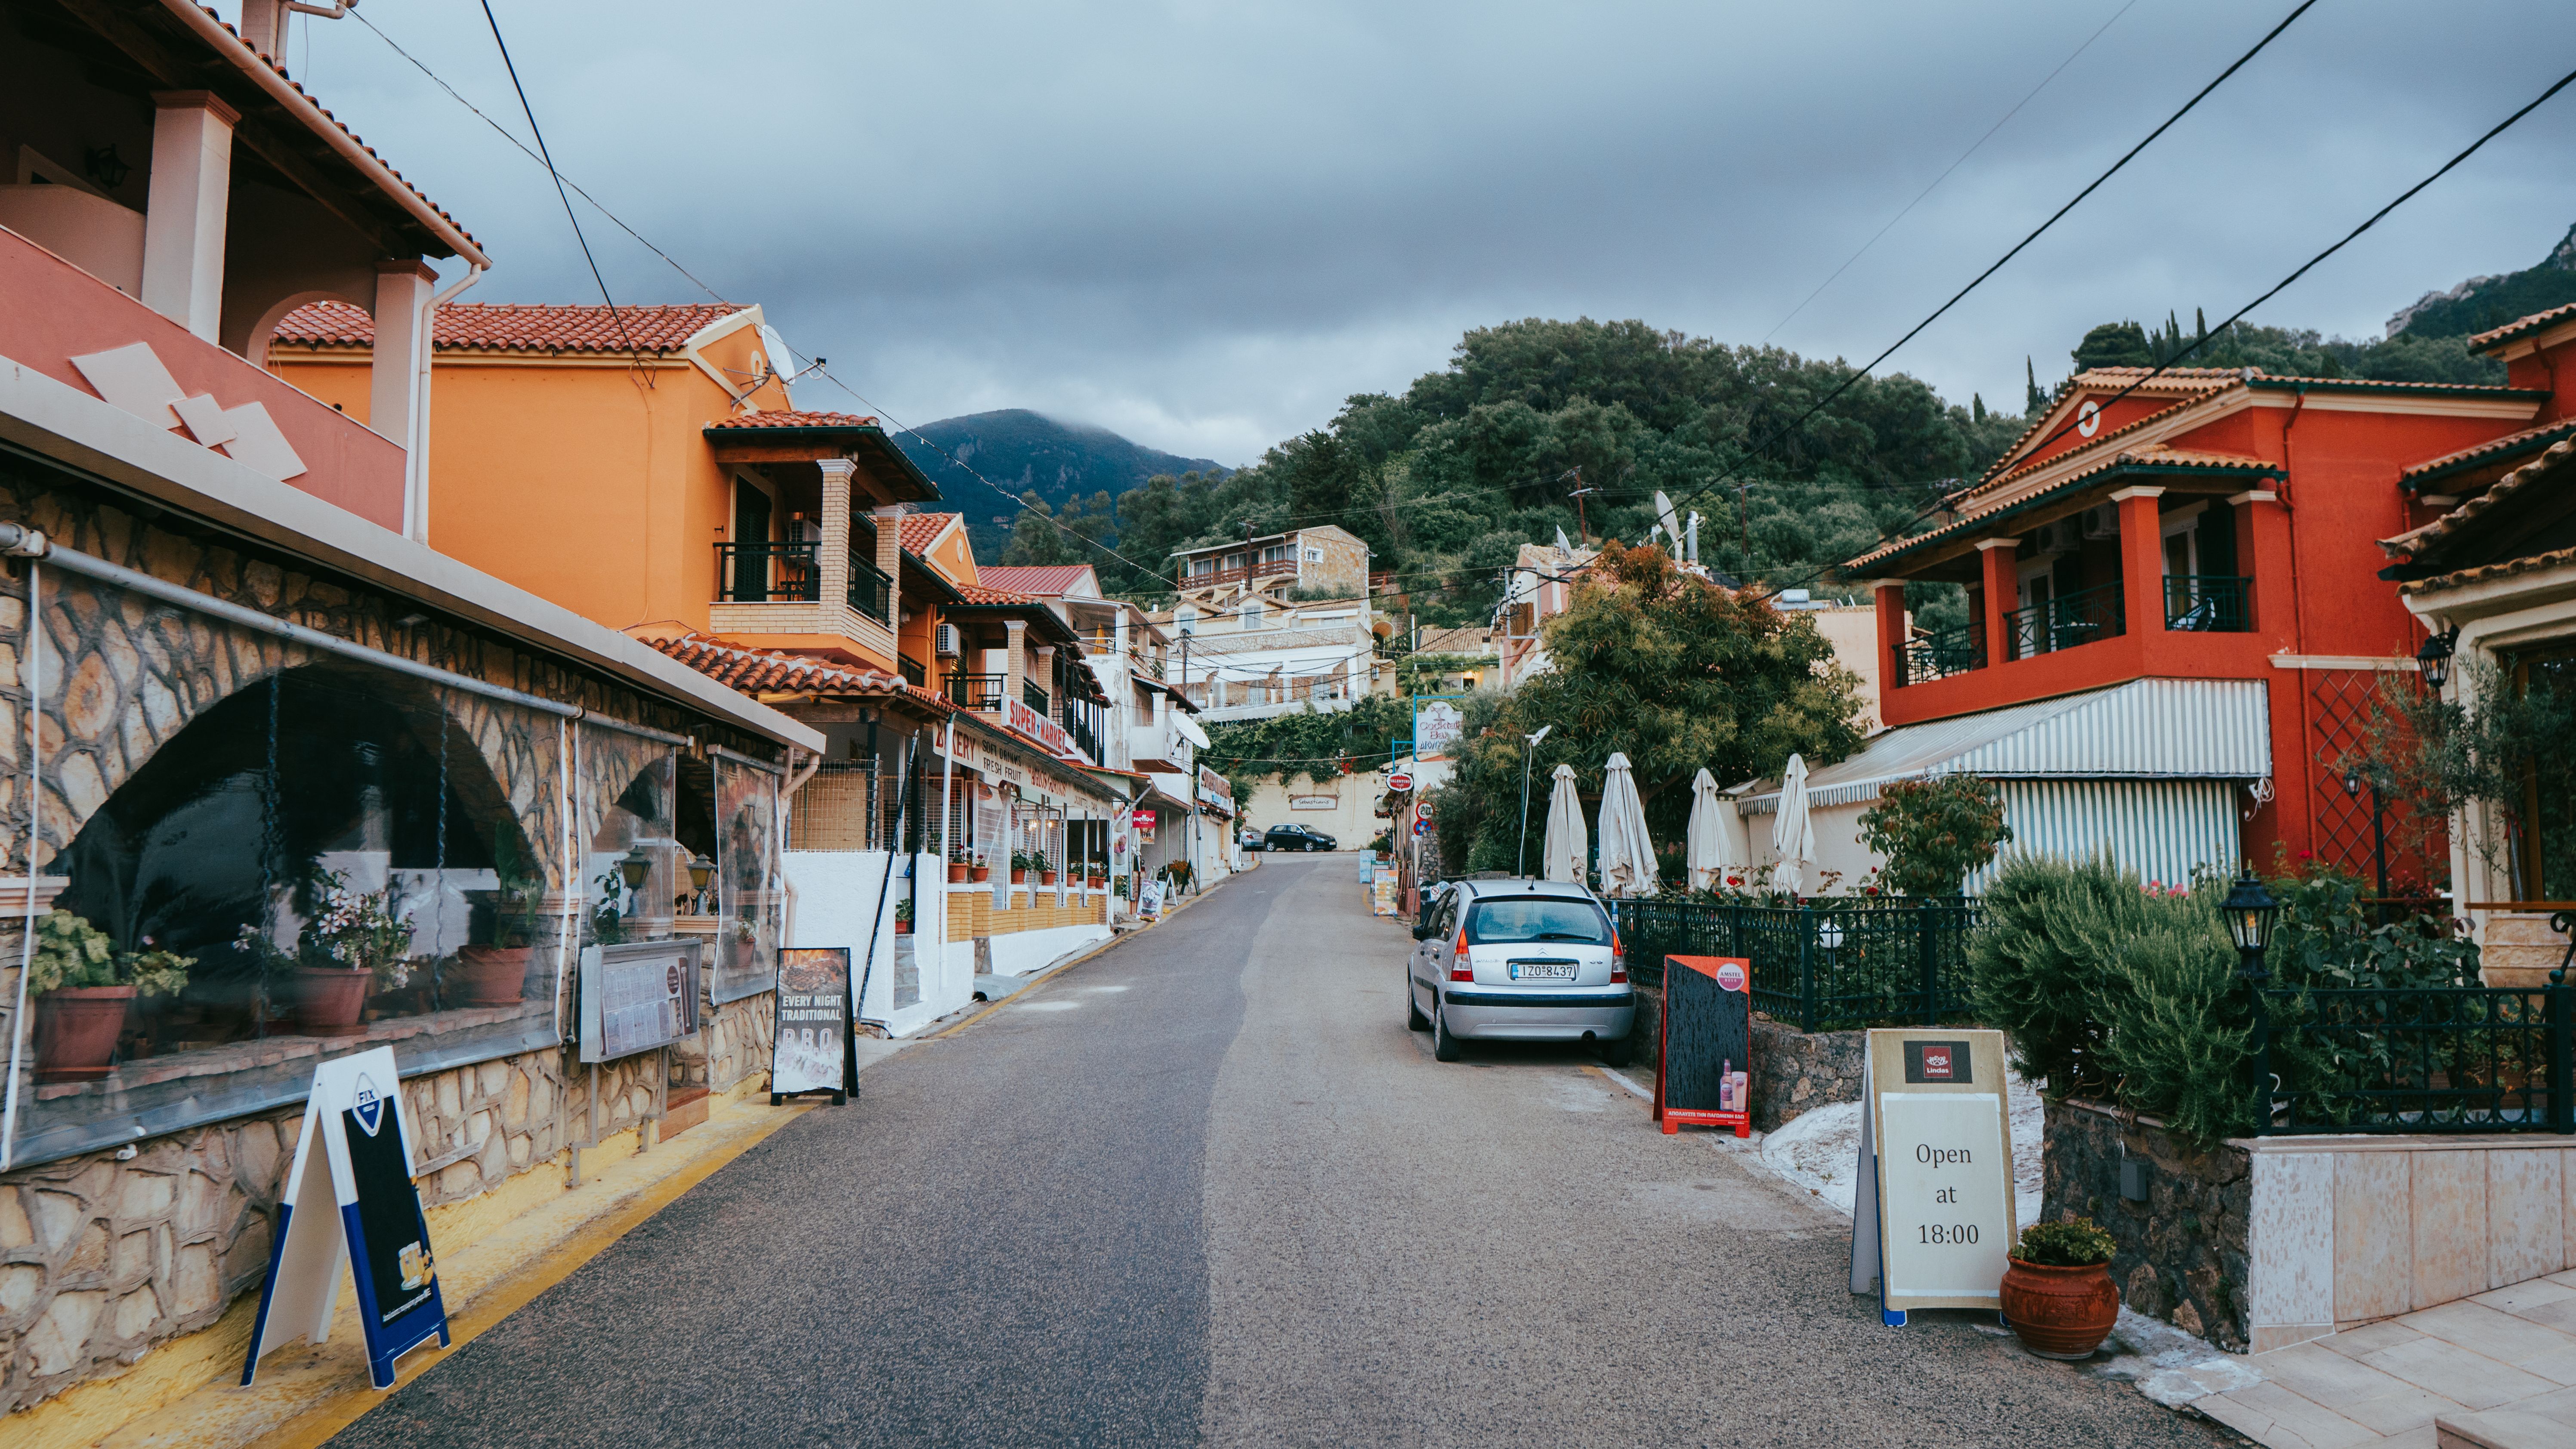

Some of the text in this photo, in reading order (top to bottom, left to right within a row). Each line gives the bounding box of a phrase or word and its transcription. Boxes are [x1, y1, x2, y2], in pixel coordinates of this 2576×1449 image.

[1010, 699, 1065, 752] SUPER MARKET
[982, 739, 996, 757] SOFT
[983, 757, 1022, 783] FRESH FRUIT
[782, 995, 842, 1007] EVERY NIGHT
[781, 1009, 842, 1021] TRADITIONAL
[358, 1088, 375, 1104] FIX
[1916, 1144, 1972, 1168] Open
[1937, 1186, 1957, 1203] at
[1918, 1224, 1979, 1244] 18:00
